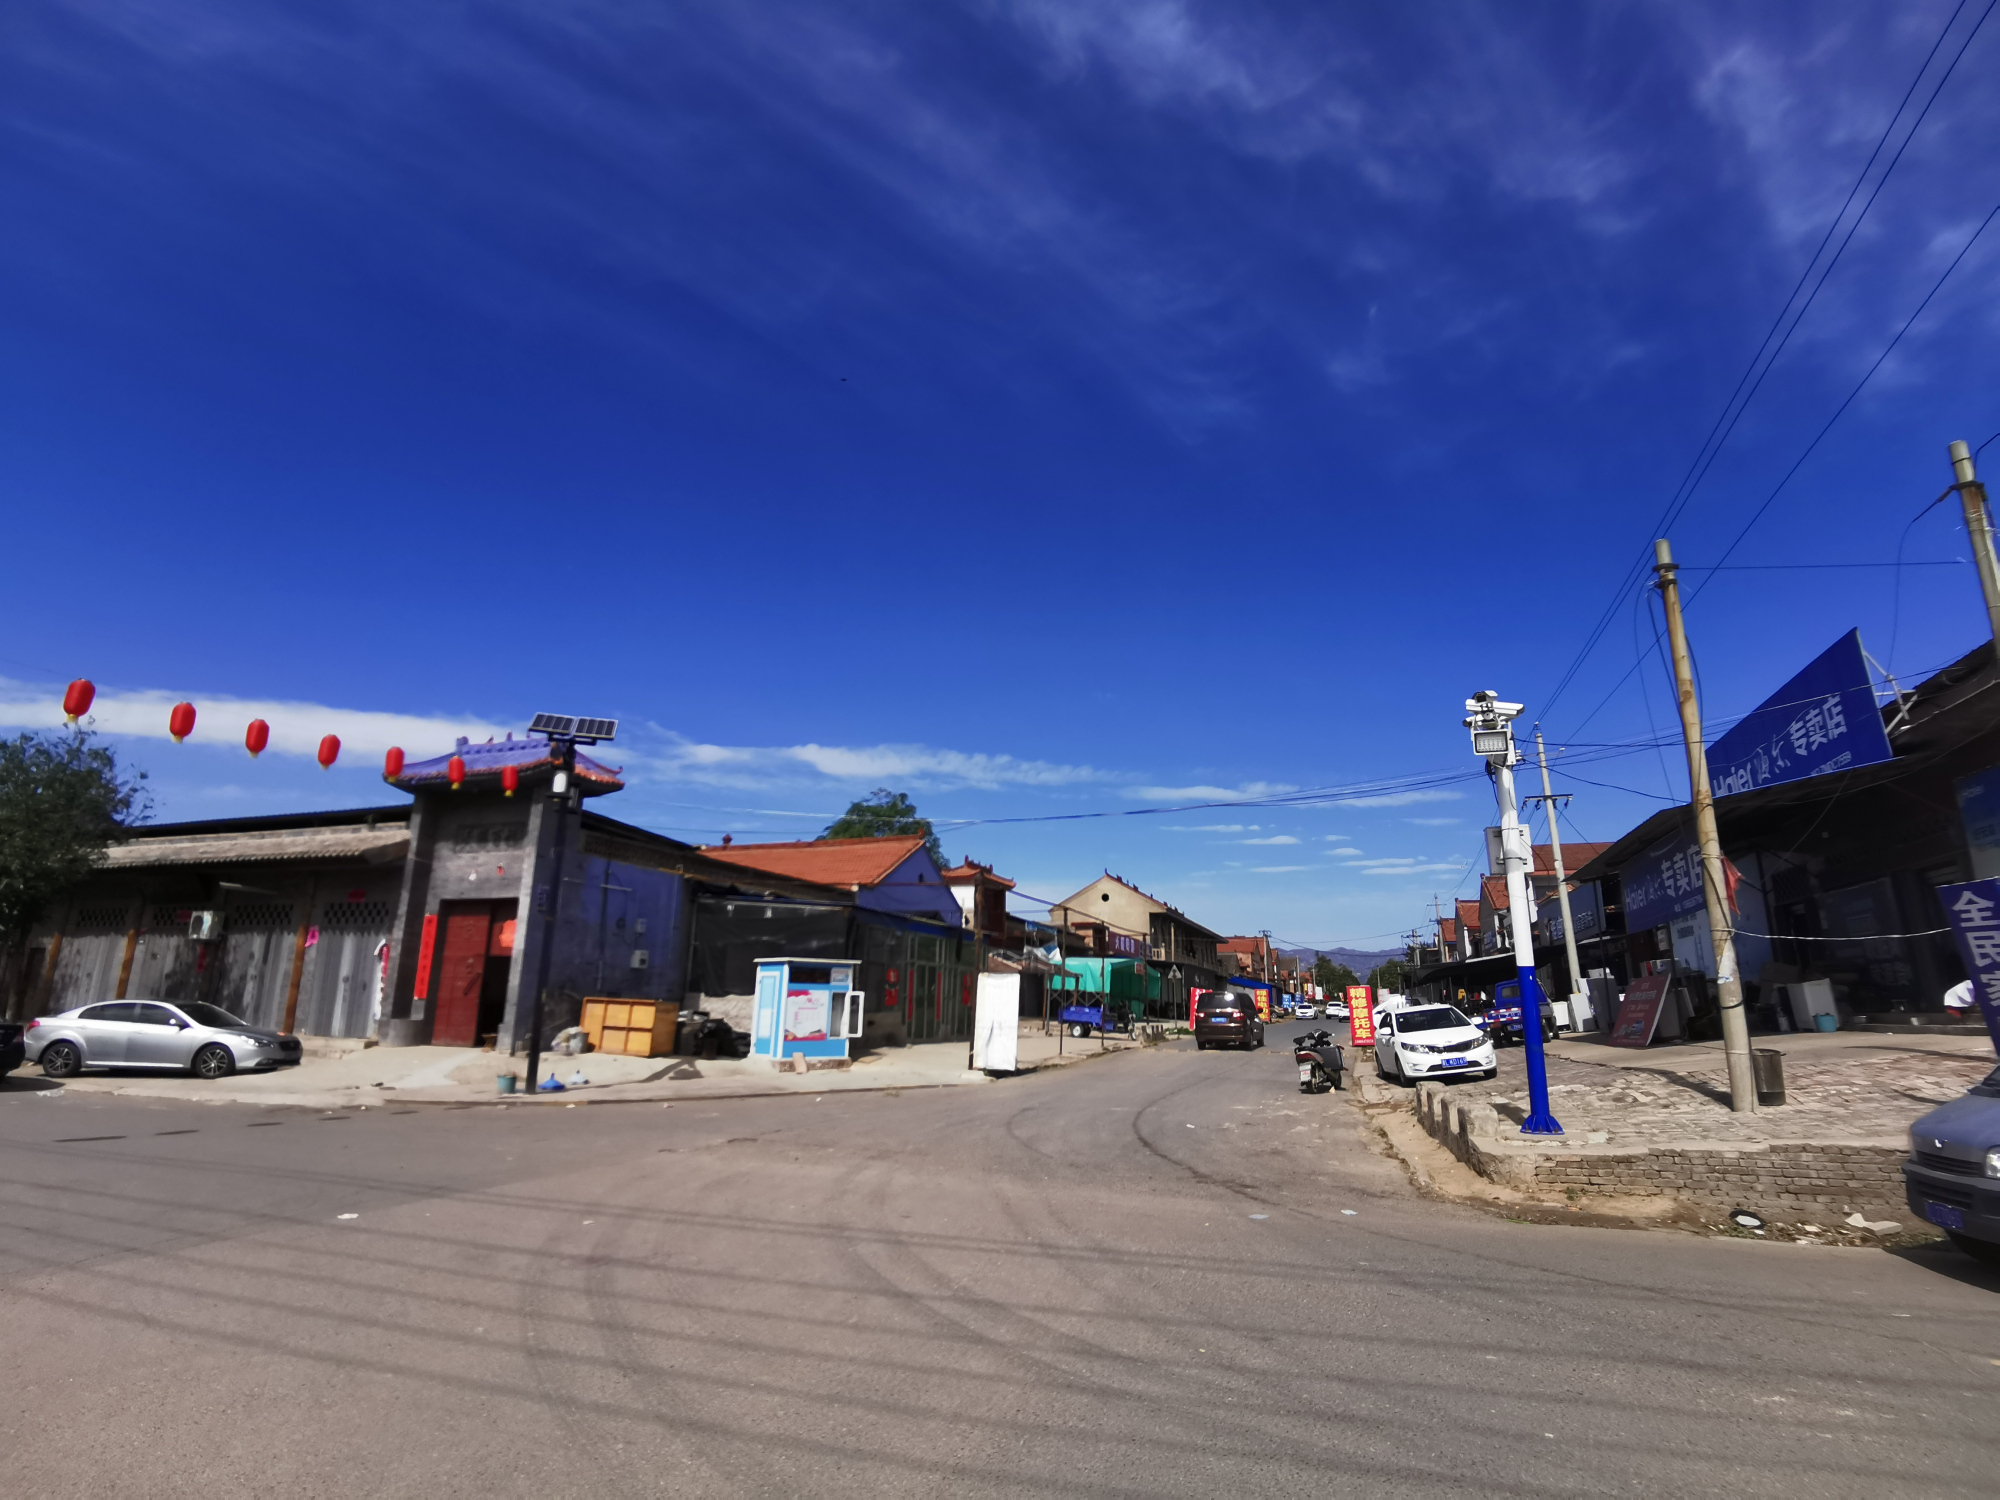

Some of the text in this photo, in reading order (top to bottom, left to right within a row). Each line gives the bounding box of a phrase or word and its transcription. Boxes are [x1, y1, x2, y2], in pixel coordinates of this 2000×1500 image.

[1713, 761, 1753, 797] Haier
[1625, 884, 1647, 912] Haier
[1349, 987, 1372, 1039] 精修摩托车
